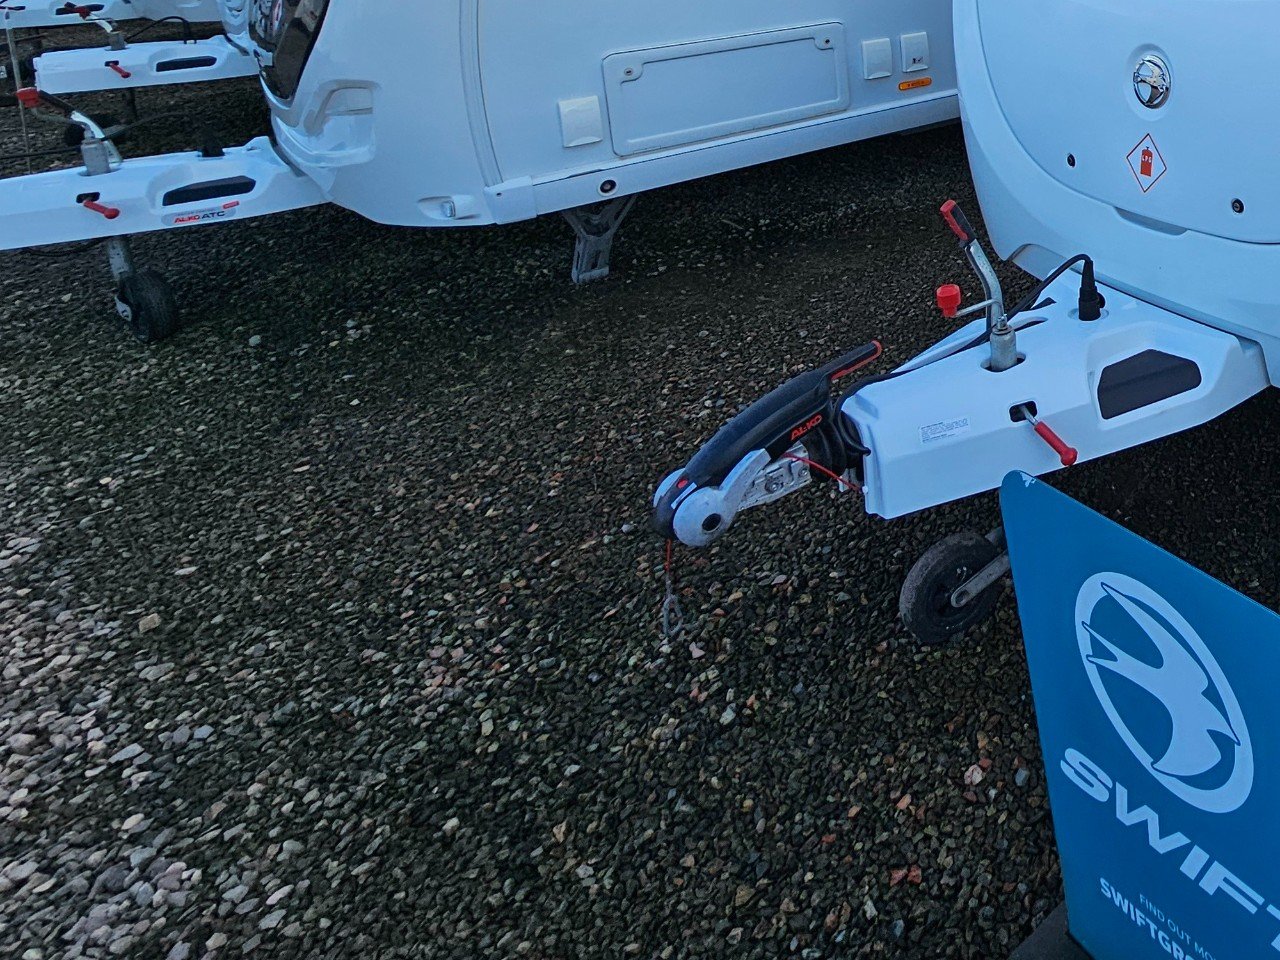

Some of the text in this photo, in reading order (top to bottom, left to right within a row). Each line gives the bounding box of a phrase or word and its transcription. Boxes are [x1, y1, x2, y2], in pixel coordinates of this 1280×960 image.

[201, 210, 226, 220] ATC
[790, 414, 823, 441] AL-KO
[1099, 877, 1195, 960] SWIFTGR
[1139, 893, 1217, 960] FIND OUT MO
